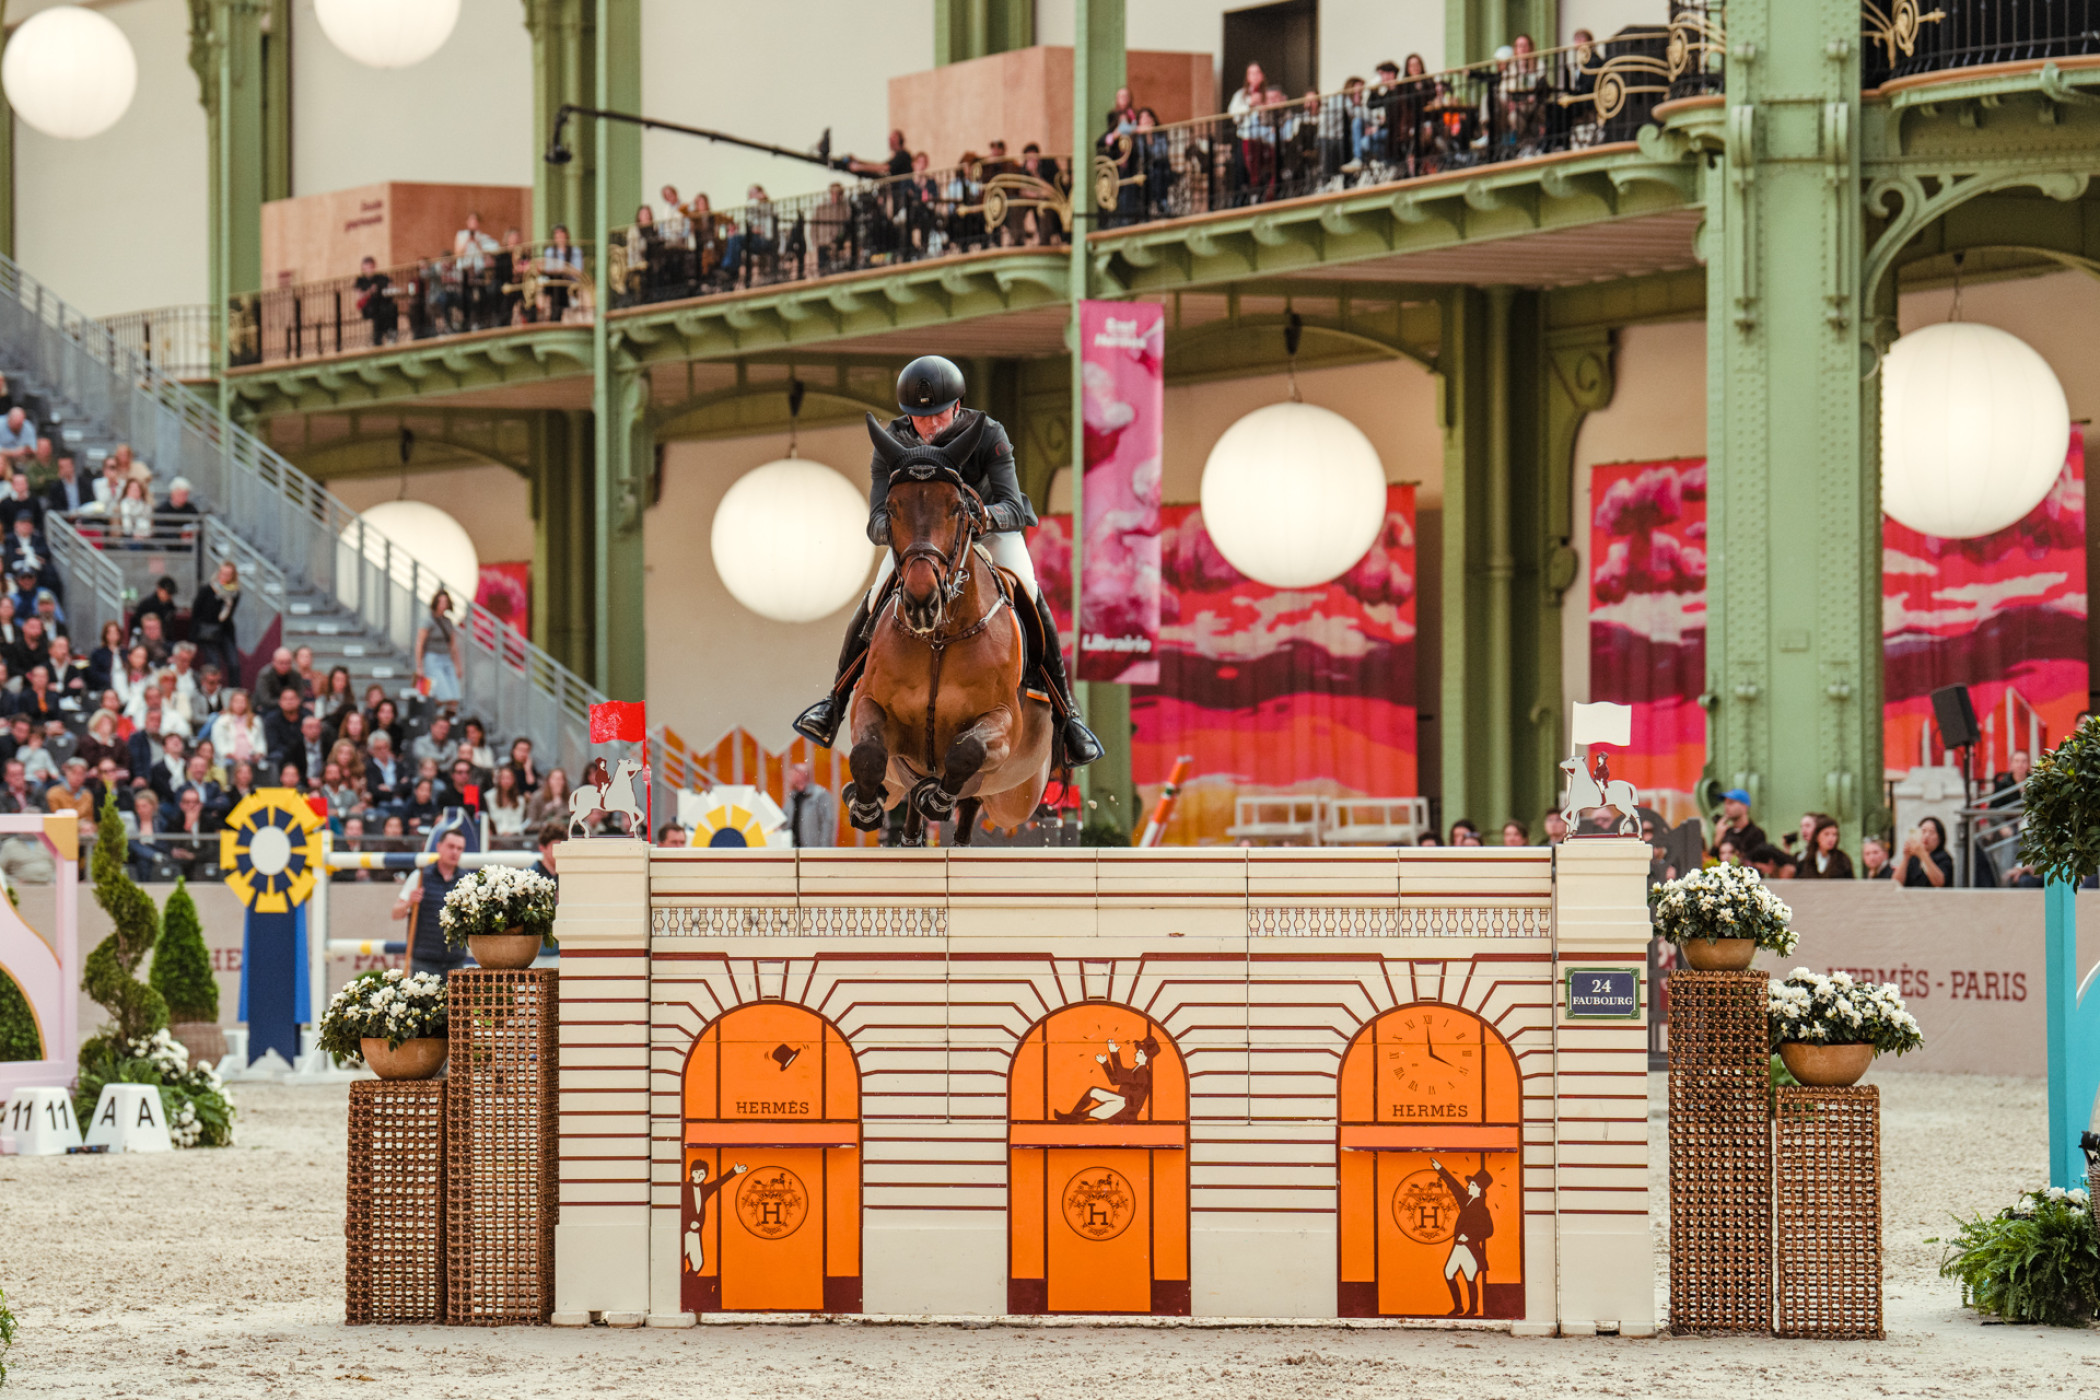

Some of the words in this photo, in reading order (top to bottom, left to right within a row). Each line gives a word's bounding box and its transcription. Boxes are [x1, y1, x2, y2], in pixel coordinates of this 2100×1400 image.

[1592, 979, 1612, 993] 24
[1951, 970, 2027, 1002] PARIS
[1573, 996, 1633, 1006] FAUBOURG
[12, 1100, 33, 1131] 11
[46, 1100, 69, 1131] 11
[100, 1096, 116, 1127] A
[137, 1097, 155, 1127] A
[736, 1100, 809, 1114] HERMÈS
[1392, 1103, 1468, 1117] HERMÈS
[761, 1202, 782, 1224] H
[1419, 1206, 1439, 1228] H
